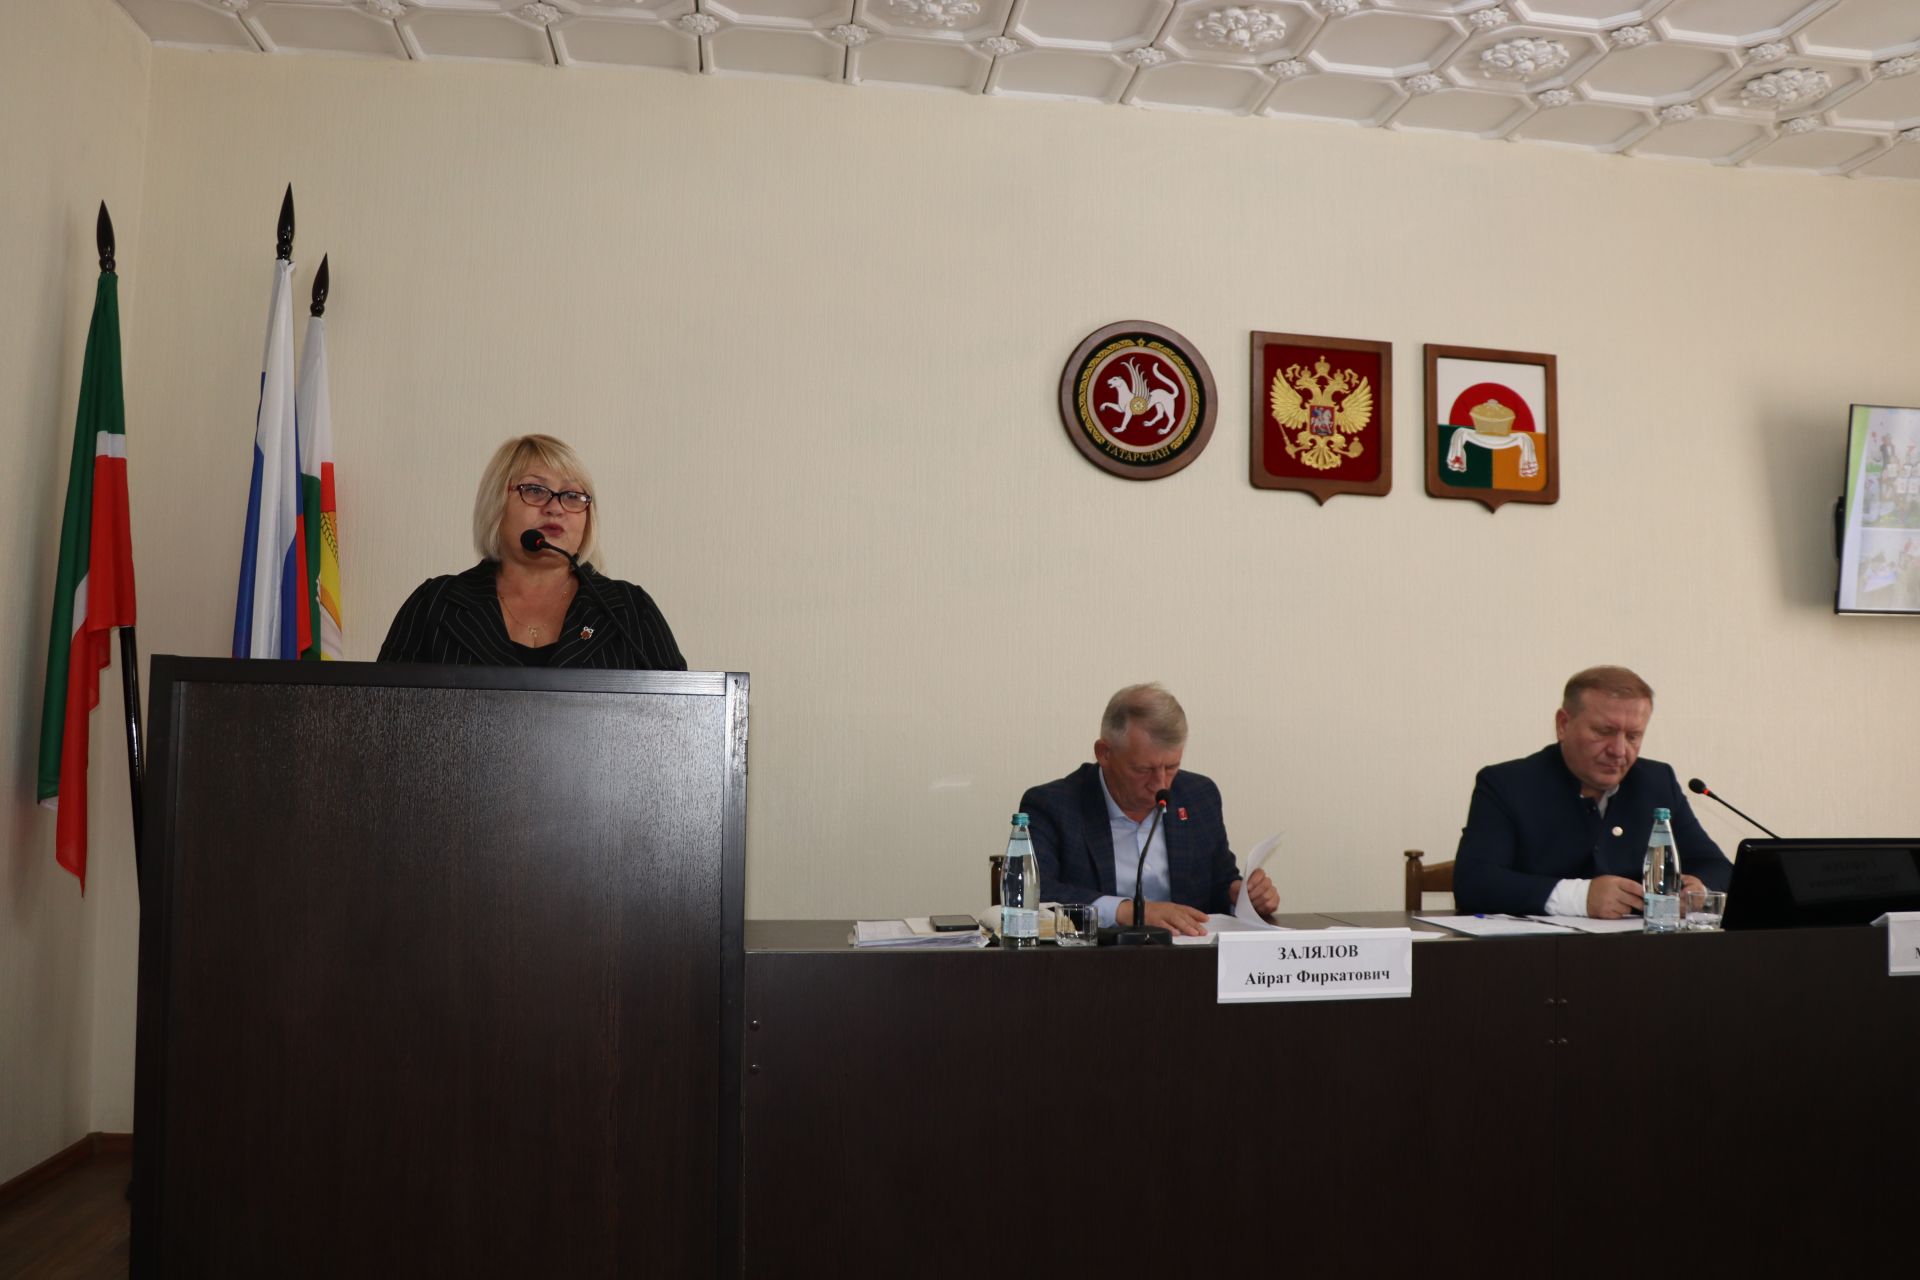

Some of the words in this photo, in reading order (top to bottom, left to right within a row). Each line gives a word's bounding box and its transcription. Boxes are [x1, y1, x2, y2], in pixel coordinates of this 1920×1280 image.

[1105, 443, 1171, 462] ТАТАРСТАН
[1277, 944, 1359, 960] ЗАЛЯЛОВ
[1244, 971, 1293, 988] Айрат
[1296, 969, 1390, 986] Фиркатович
